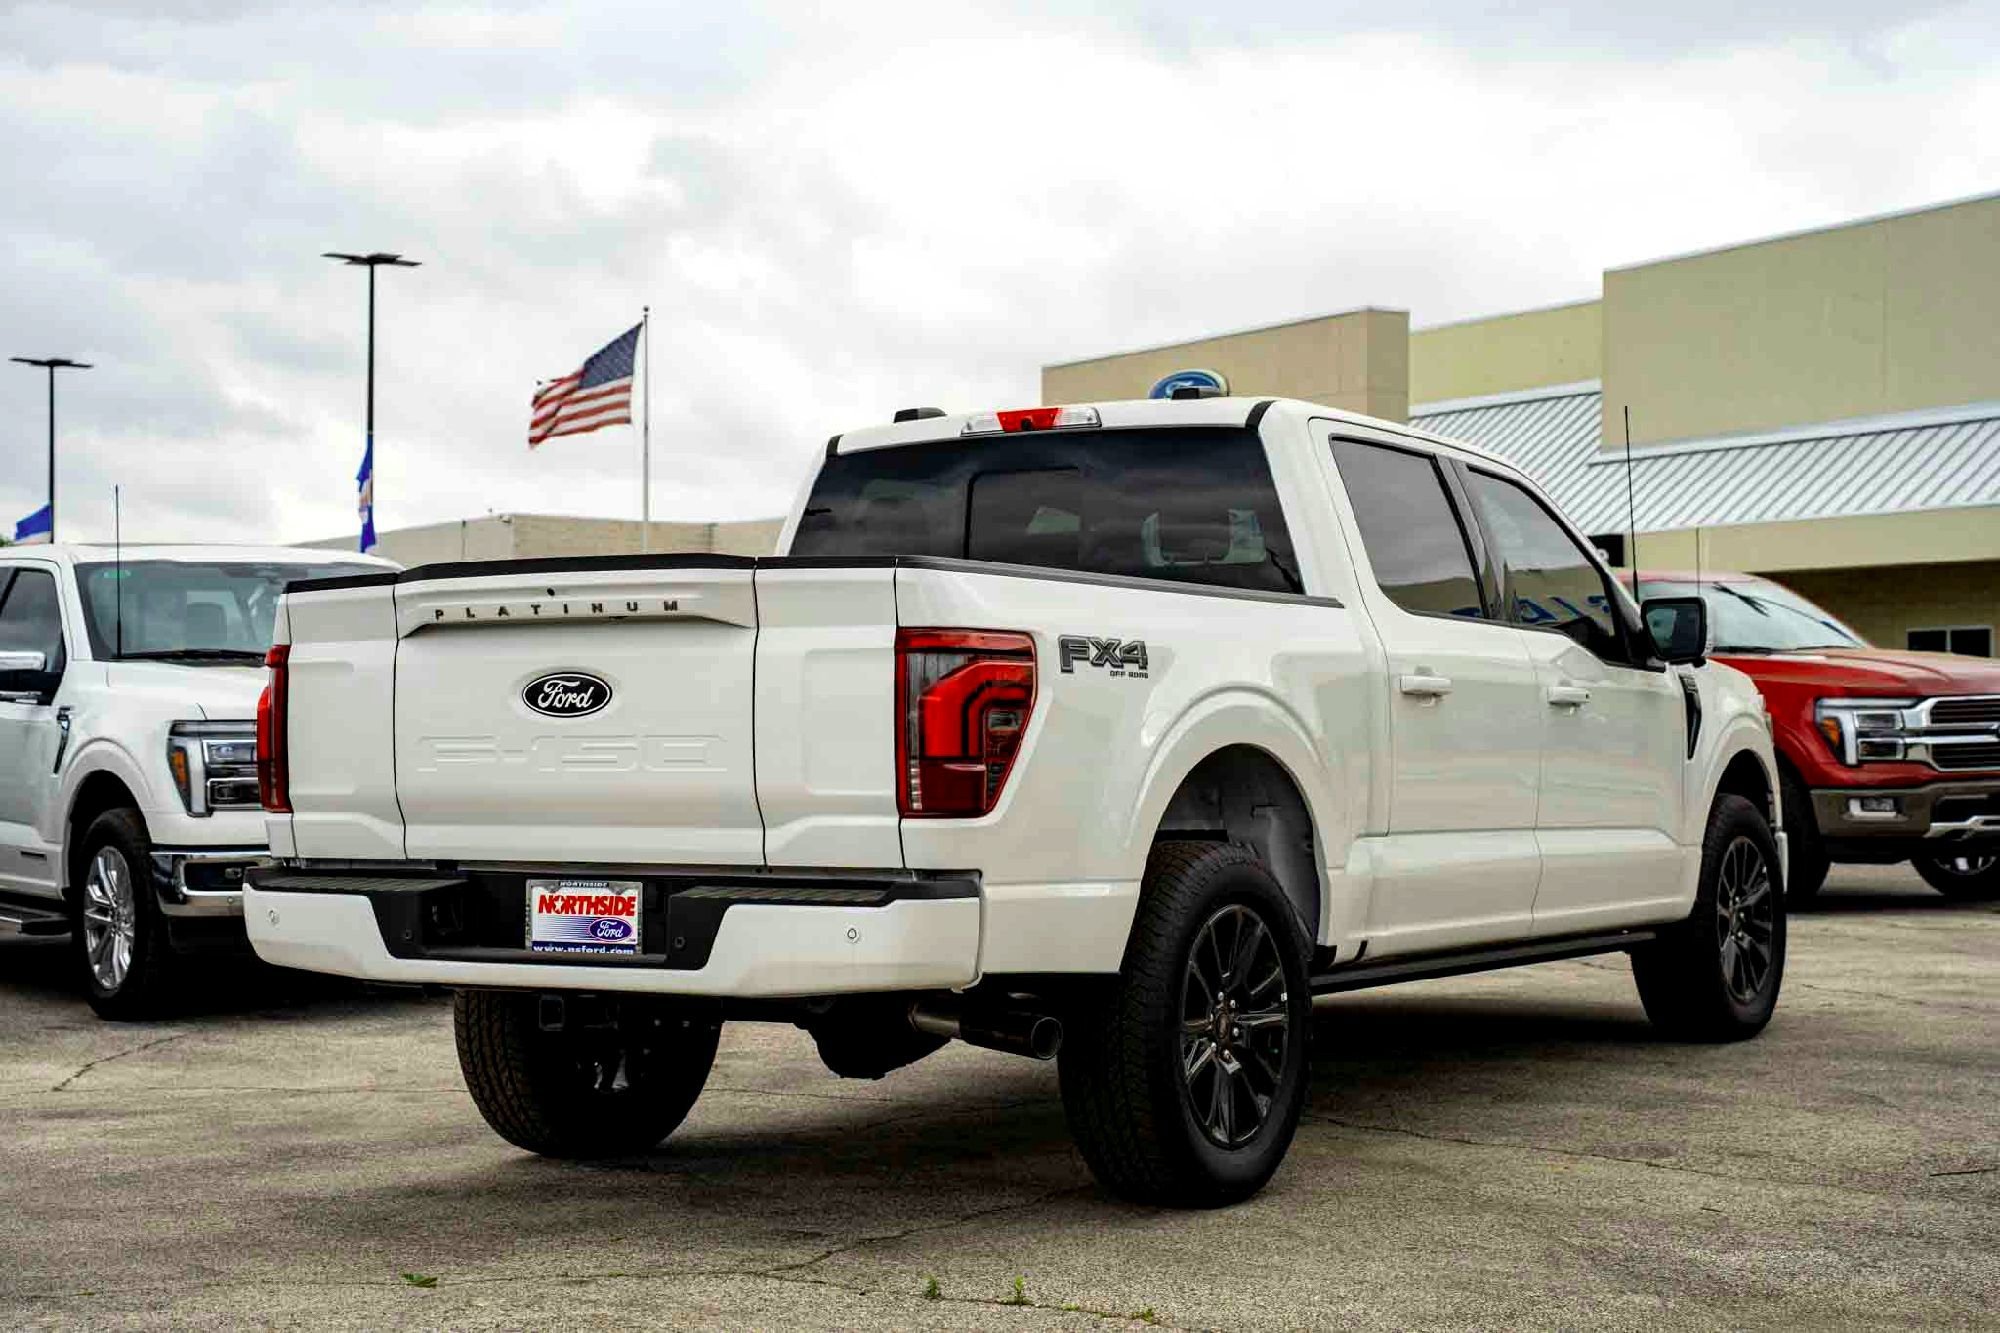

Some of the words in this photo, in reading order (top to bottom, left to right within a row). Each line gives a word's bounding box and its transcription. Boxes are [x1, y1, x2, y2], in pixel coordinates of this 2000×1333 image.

[435, 600, 678, 619] PLATINUM
[1058, 635, 1149, 673] FX4
[1128, 671, 1149, 679] ROAD
[537, 680, 593, 709] Ford
[416, 734, 727, 772] F-150
[538, 895, 636, 916] NORTHSIDE
[596, 920, 624, 938] Ford
[533, 945, 634, 954] www.nsford.com
